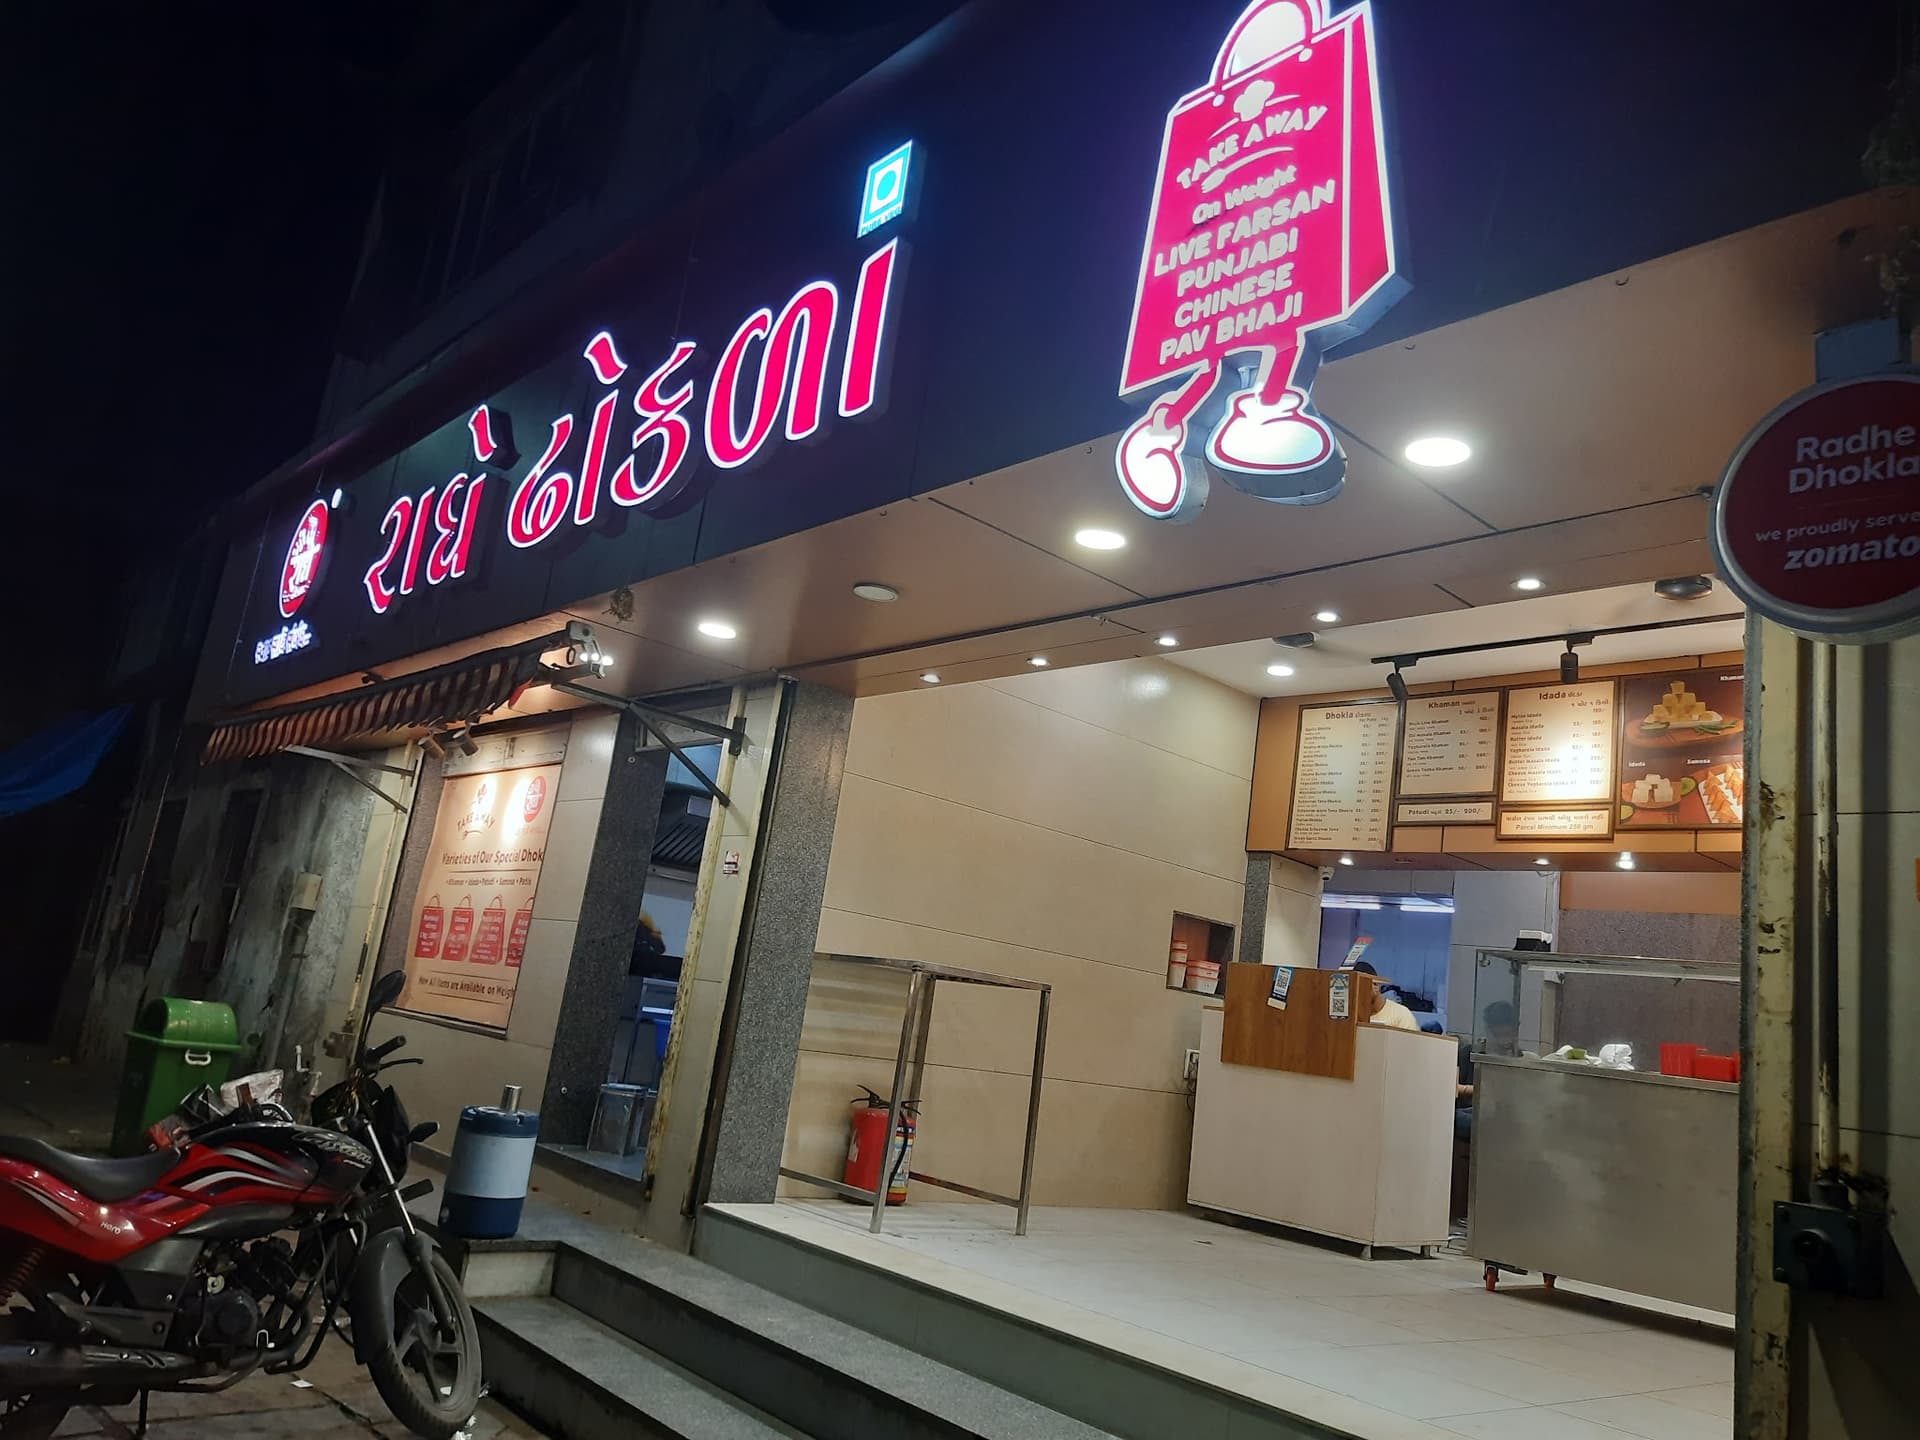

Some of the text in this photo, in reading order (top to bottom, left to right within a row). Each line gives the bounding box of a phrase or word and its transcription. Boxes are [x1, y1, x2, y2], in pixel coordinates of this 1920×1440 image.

[1176, 105, 1328, 190] TAKE AWAY
[1192, 165, 1297, 225] On Weight
[1154, 179, 1335, 277] LIVE FARSAN
[1177, 227, 1299, 297] PUNJABI
[1174, 262, 1295, 327] CHINESE
[1159, 292, 1303, 365] PAV BHAJI
[363, 236, 898, 614] રાધે ઢોકળા
[1796, 424, 1916, 463] Radhe
[1789, 452, 1920, 493] Dhokla
[1755, 528, 1782, 542] we
[1786, 516, 1860, 541] proudly
[1784, 533, 1920, 570] zomato
[1326, 712, 1353, 720] Dhokla
[1428, 701, 1460, 709] Khaman
[1539, 692, 1566, 700] Idada
[442, 852, 472, 865] Varieties
[472, 851, 480, 864] of
[480, 850, 493, 864] Our
[494, 849, 521, 866] Special
[450, 981, 459, 990] are
[487, 986, 495, 995] on
